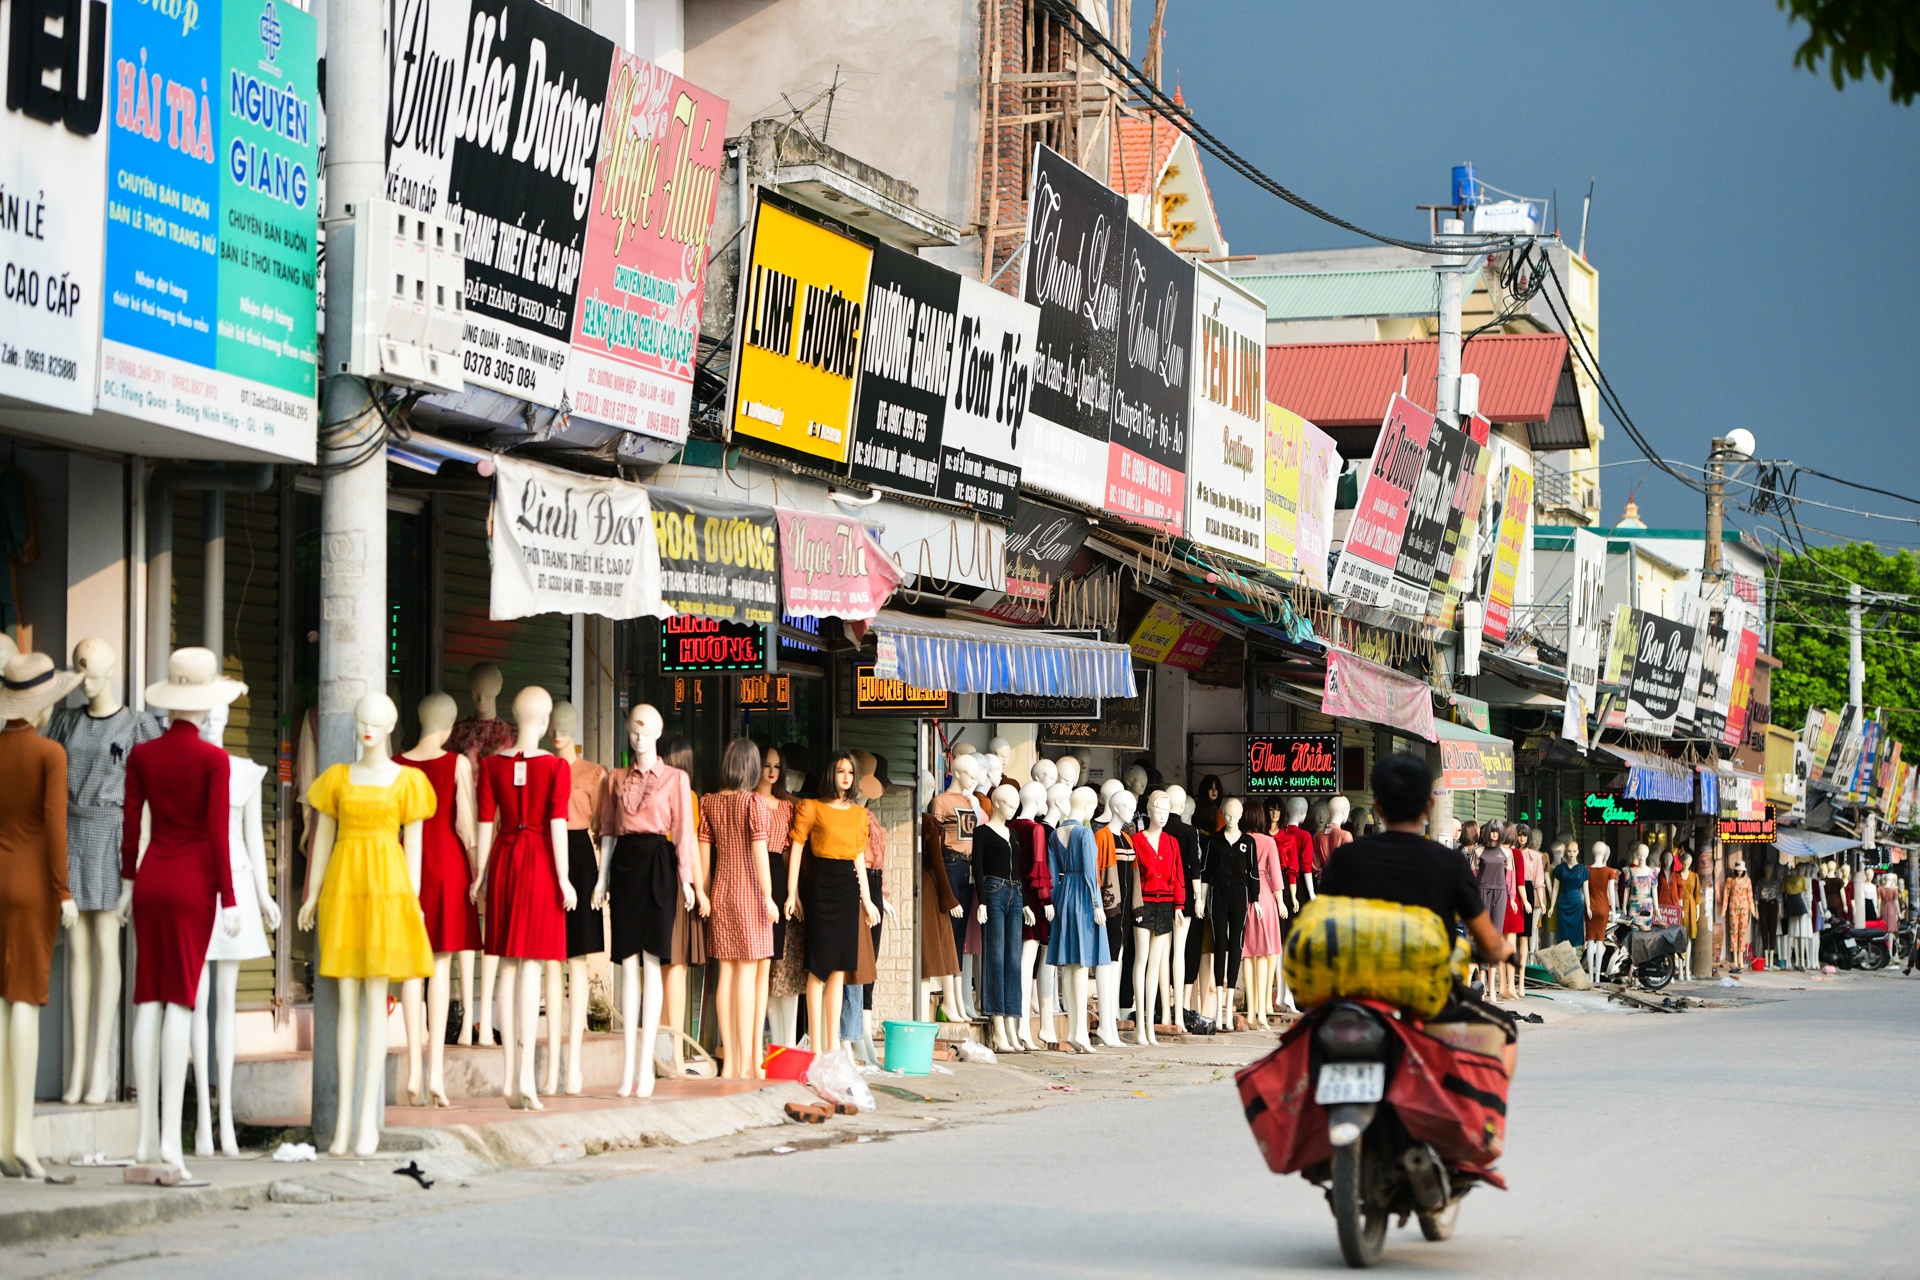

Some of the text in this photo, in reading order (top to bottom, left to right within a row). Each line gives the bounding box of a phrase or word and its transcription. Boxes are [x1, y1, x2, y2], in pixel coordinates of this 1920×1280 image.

[118, 169, 210, 220] CHUYÊN BÁN BUÔN
[230, 138, 309, 208] GIANG
[400, 178, 418, 209] CAO
[418, 175, 437, 215] CẤP
[25, 190, 45, 240] LẺ
[109, 200, 130, 225] BÁN
[144, 212, 166, 238] THỜI
[169, 222, 200, 250] TRANG
[229, 209, 307, 254] CHUYÊN BÁN BUÔN
[221, 239, 239, 263] BÁN
[251, 251, 271, 274] THỜI
[273, 259, 300, 286] TRANG
[463, 208, 581, 295] TRANG THIẾT KẾ CAO CẤP
[1034, 171, 1120, 332] Thanh Lam
[5, 262, 80, 318] CAO CẤP
[464, 276, 567, 331] ĐẶT HÀNG THEO MẪU
[614, 264, 677, 307] CHUYÊN BÁN BUÔN
[745, 264, 797, 357] LINH
[660, 323, 676, 360] CAO
[1127, 248, 1184, 388] Thanh Lam
[463, 350, 536, 390] 0378 305 084
[506, 335, 531, 361] ĐƯỜNG
[530, 348, 548, 367] NINH
[548, 350, 565, 374] HIỆP
[911, 302, 954, 397] GIANG
[1201, 297, 1261, 422] YẾN LINH
[954, 314, 1027, 450] Tôm Tép
[902, 408, 915, 439] 999
[915, 412, 928, 443] 755
[1114, 389, 1183, 454] Chuyên Váy bộ Áo
[1121, 451, 1131, 480] ĐT:
[1131, 457, 1147, 487] 0904
[1160, 470, 1172, 497] 914
[1222, 425, 1254, 482] Boutique
[517, 478, 579, 541] Linh
[965, 484, 977, 503] 036
[977, 488, 989, 506] 625
[541, 548, 568, 570] TRANG
[570, 548, 592, 573] THIẾT
[606, 558, 624, 576] CAO
[704, 516, 775, 572] DƯƠNG
[789, 517, 832, 586] Ngọc
[1027, 518, 1073, 561] Lam
[680, 636, 758, 663] HƯƠNG
[1639, 621, 1665, 668] Bon
[1665, 630, 1689, 674] Bon
[1047, 699, 1069, 709] CAO
[1124, 724, 1139, 738] 15
[1250, 742, 1287, 773] Thu
[1251, 775, 1333, 787] ĐAI VÁY KHUYÊN TAI
[1738, 821, 1761, 833] TRANG
